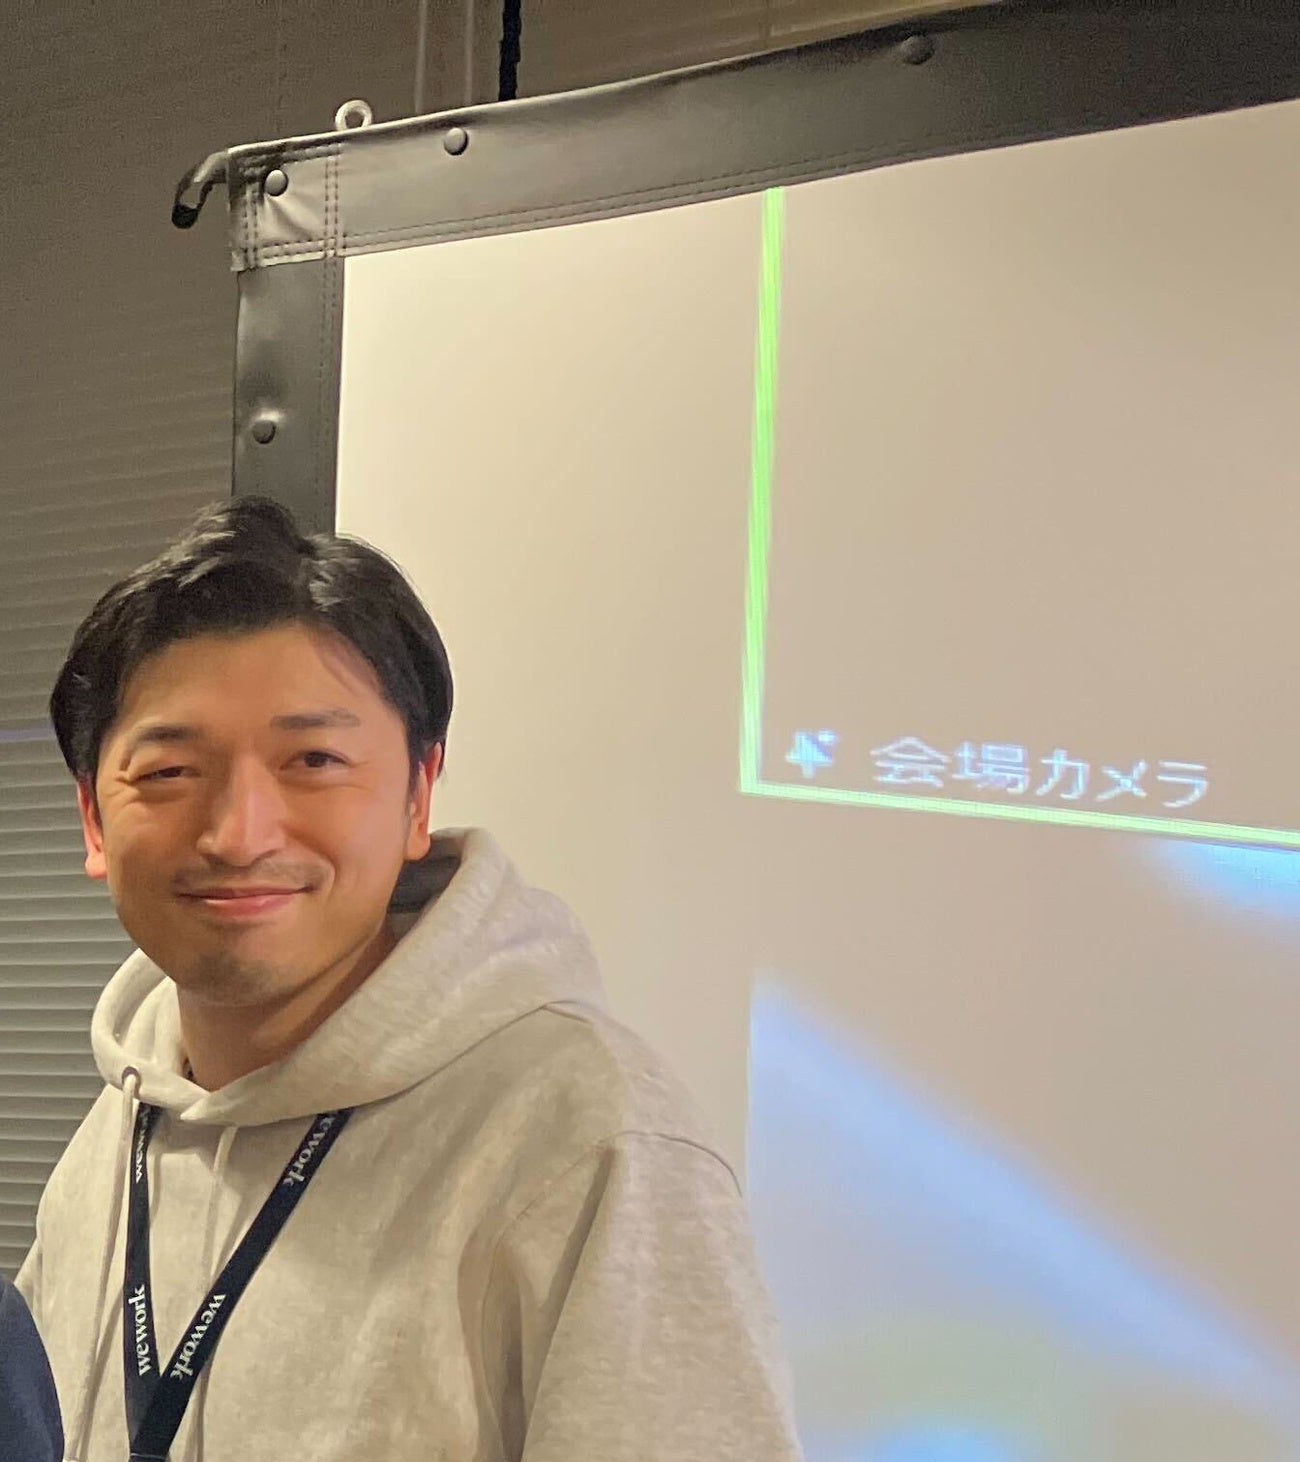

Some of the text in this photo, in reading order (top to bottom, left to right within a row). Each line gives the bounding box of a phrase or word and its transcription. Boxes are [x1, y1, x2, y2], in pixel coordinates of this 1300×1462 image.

[869, 736, 1210, 808] 会場カメラ
[282, 1116, 336, 1186] ework
[128, 1283, 152, 1376] wework
[170, 1293, 227, 1380] wework
